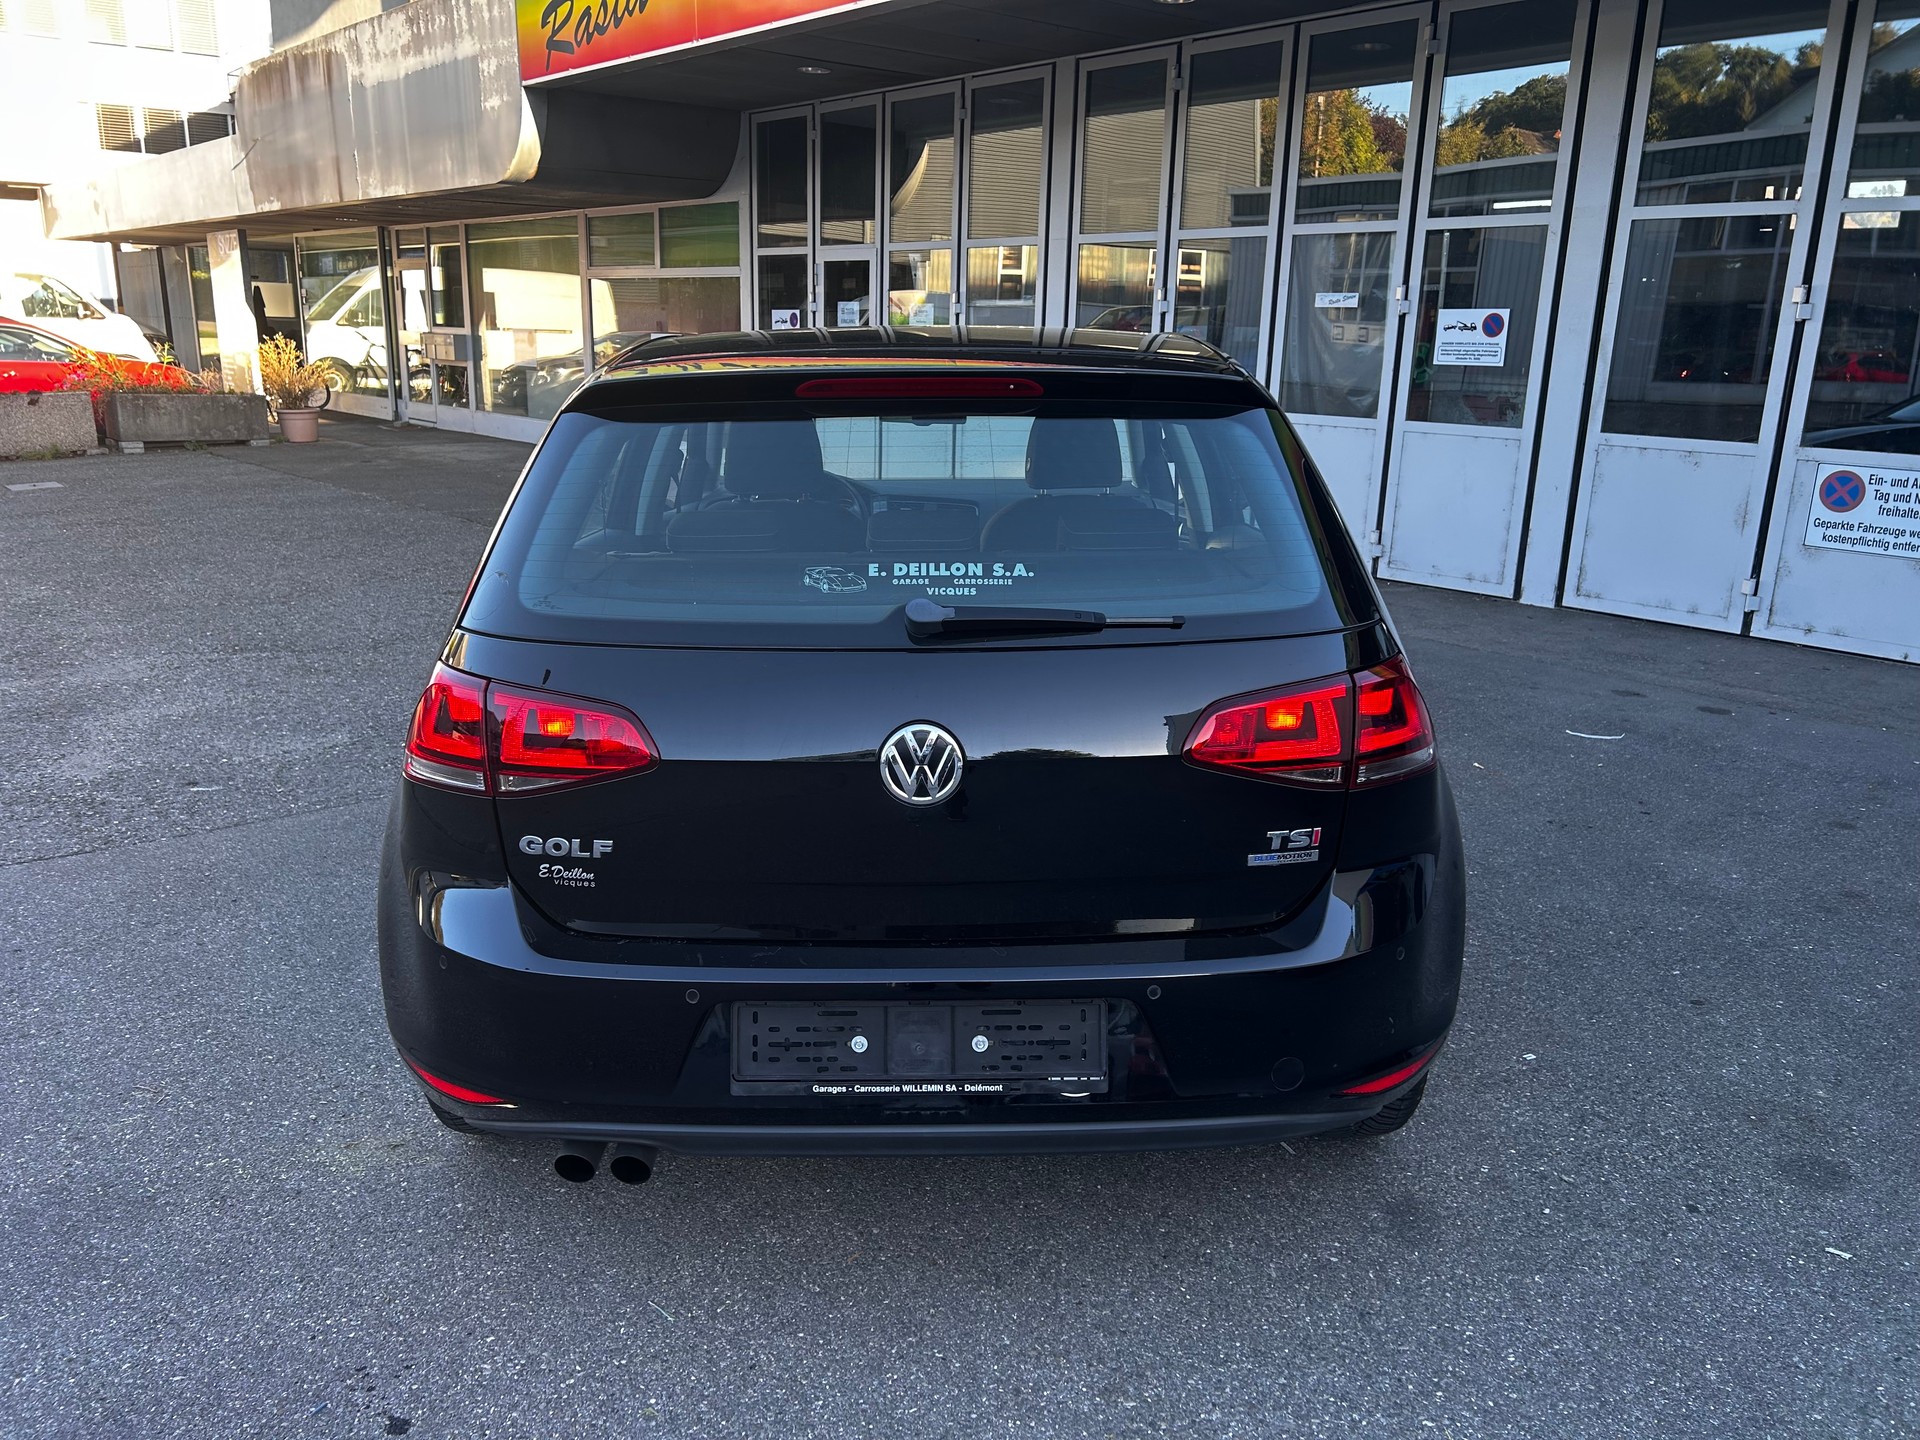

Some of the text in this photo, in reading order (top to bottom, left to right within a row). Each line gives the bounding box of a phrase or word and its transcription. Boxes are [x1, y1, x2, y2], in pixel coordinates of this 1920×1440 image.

[1868, 474, 1920, 489] Ein- und A
[1874, 489, 1890, 503] Tag
[1893, 492, 1911, 504] und
[1878, 505, 1920, 519] freihalte
[1813, 517, 1854, 532] Geparkte
[1857, 522, 1906, 538] Fahrzeuge
[1822, 532, 1890, 551] kostenpflichtig
[868, 562, 1035, 577] E. DEILLON S.A.
[926, 587, 978, 596] VICQUES
[1266, 827, 1322, 850] TSI
[518, 835, 614, 859] GOLF
[812, 1085, 847, 1094] Garages
[854, 1083, 900, 1094] Carrosserie
[902, 1084, 943, 1093] WILLEMIN
[945, 1084, 957, 1093] SA
[964, 1083, 1003, 1094] Delémont
